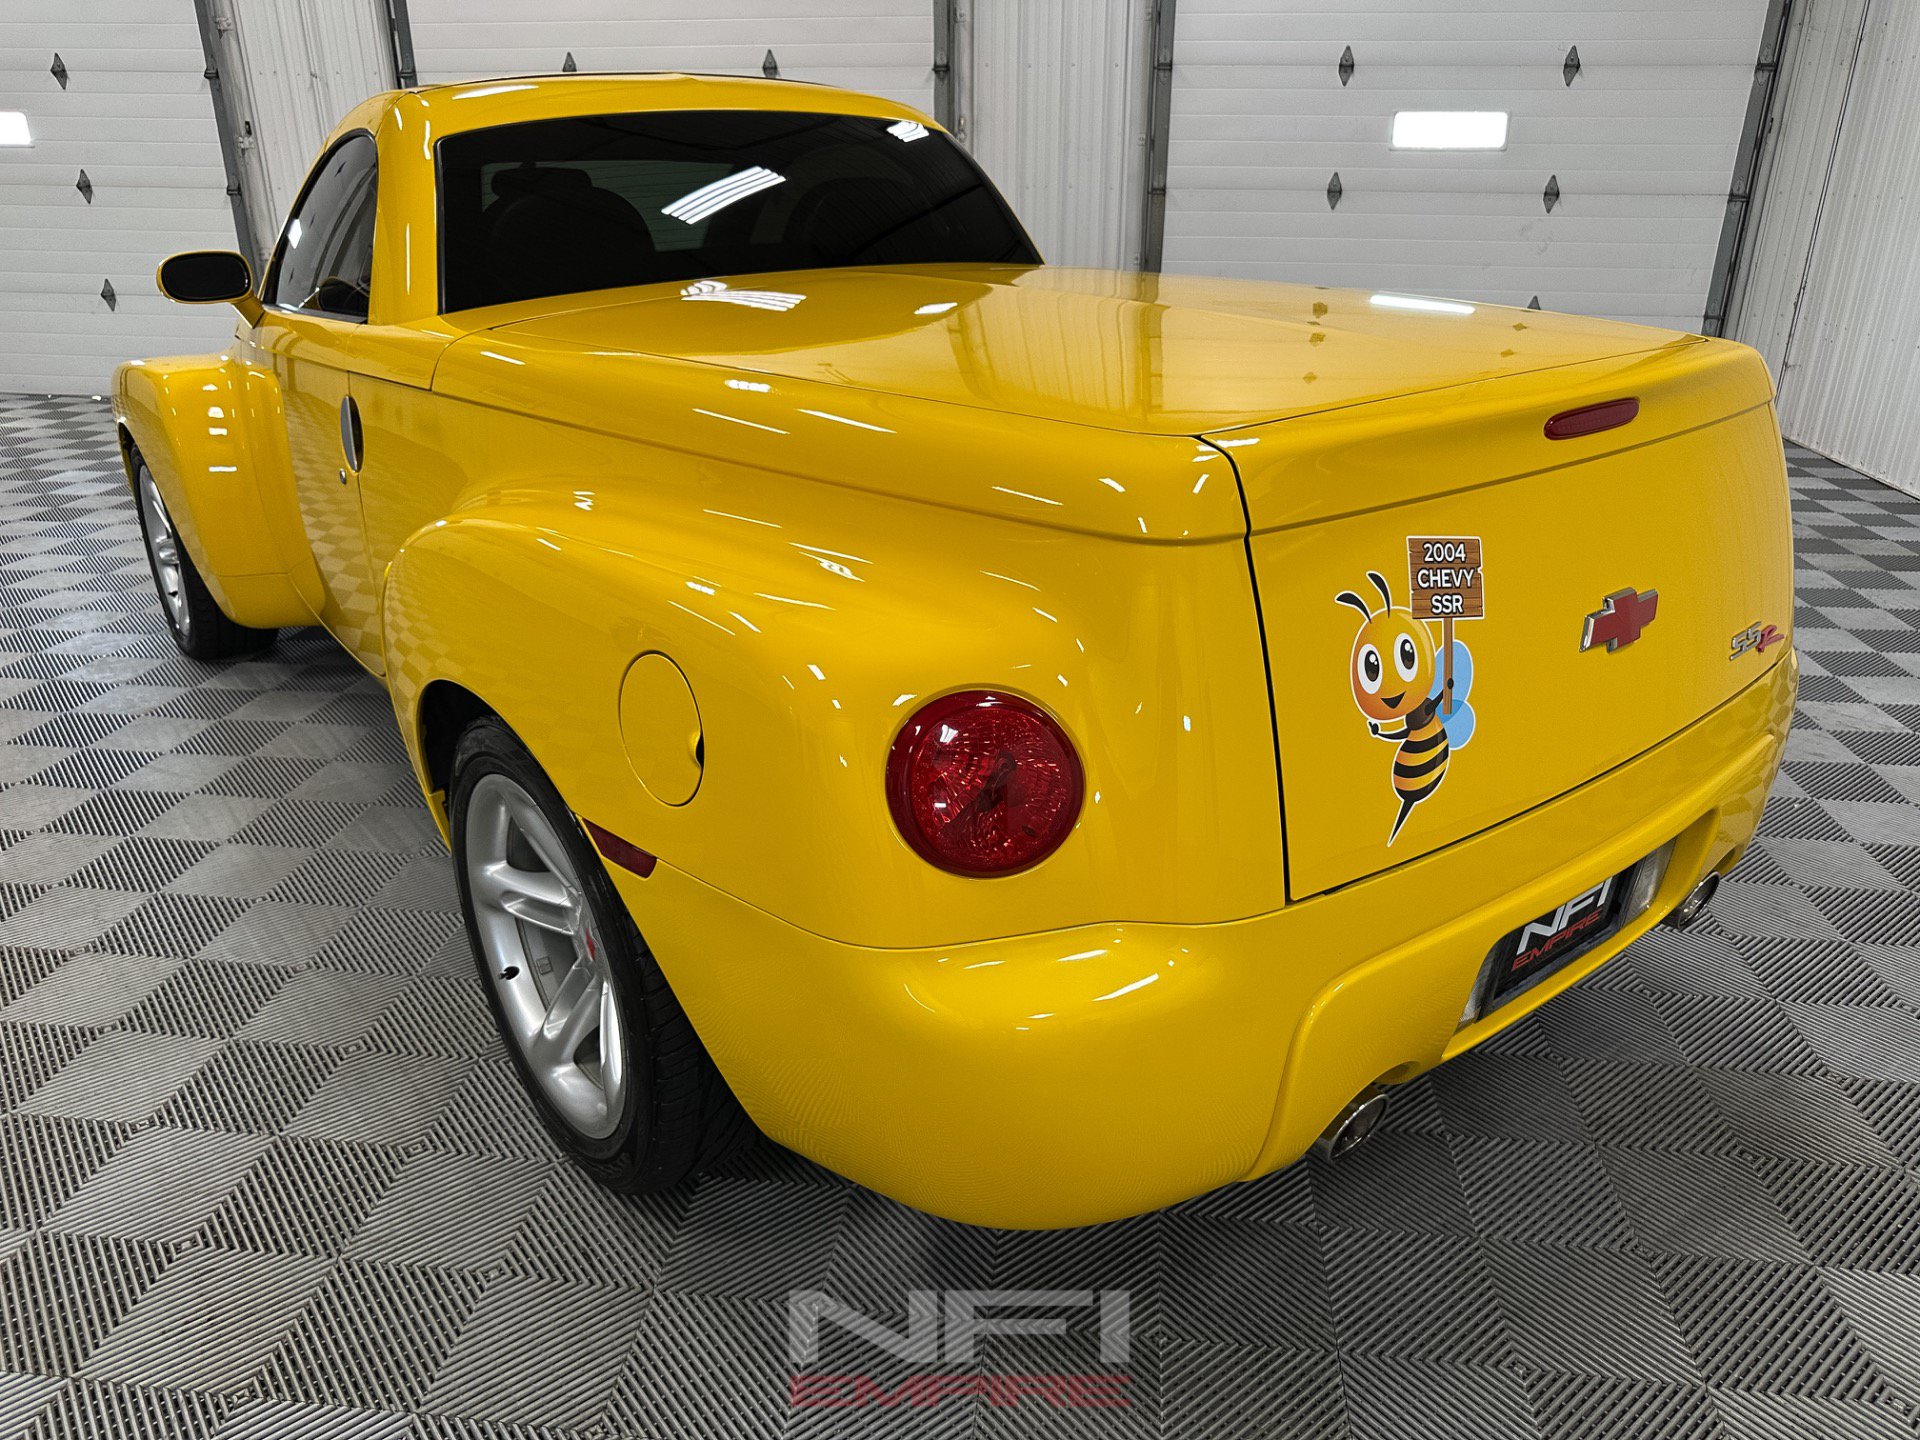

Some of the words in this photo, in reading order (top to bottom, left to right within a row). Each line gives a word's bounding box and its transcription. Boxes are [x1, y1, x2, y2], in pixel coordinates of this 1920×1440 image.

[1423, 543, 1466, 562] 2004
[1417, 568, 1474, 588] CHEVY
[1431, 594, 1463, 614] SSR
[1729, 621, 1785, 661] SSR
[1516, 876, 1612, 956] NFI
[1511, 908, 1601, 972] EMPIRE
